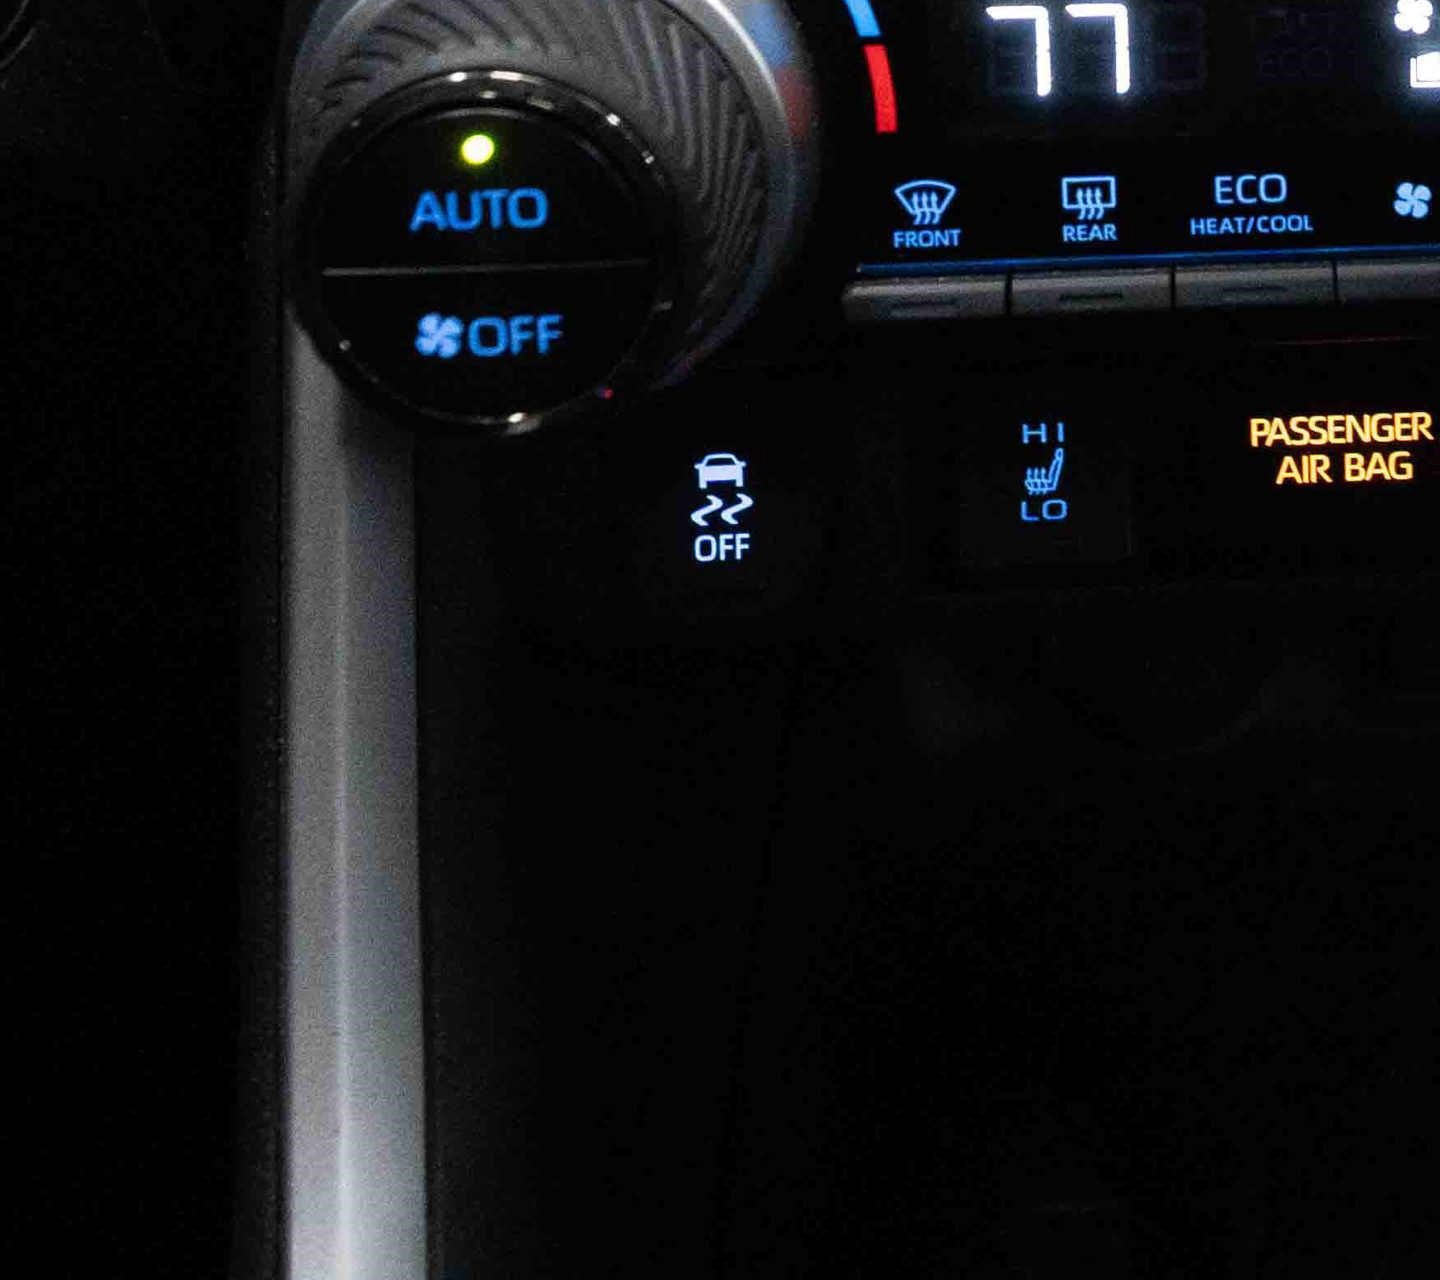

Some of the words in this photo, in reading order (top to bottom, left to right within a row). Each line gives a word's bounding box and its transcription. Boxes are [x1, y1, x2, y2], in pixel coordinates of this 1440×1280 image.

[985, 1, 1132, 99] 77
[1214, 173, 1288, 205] ECO
[409, 187, 548, 231] AUTO
[1189, 214, 1313, 235] HEAT/COOL
[893, 228, 961, 248] FRONT
[1062, 223, 1117, 242] REAR
[465, 310, 566, 360] OFF
[1022, 422, 1065, 444] HI
[1249, 411, 1435, 448] PASSENGER
[1275, 454, 1333, 485] AIR
[1343, 450, 1414, 482] BAG
[1020, 498, 1068, 522] LO
[694, 532, 750, 562] OFF
